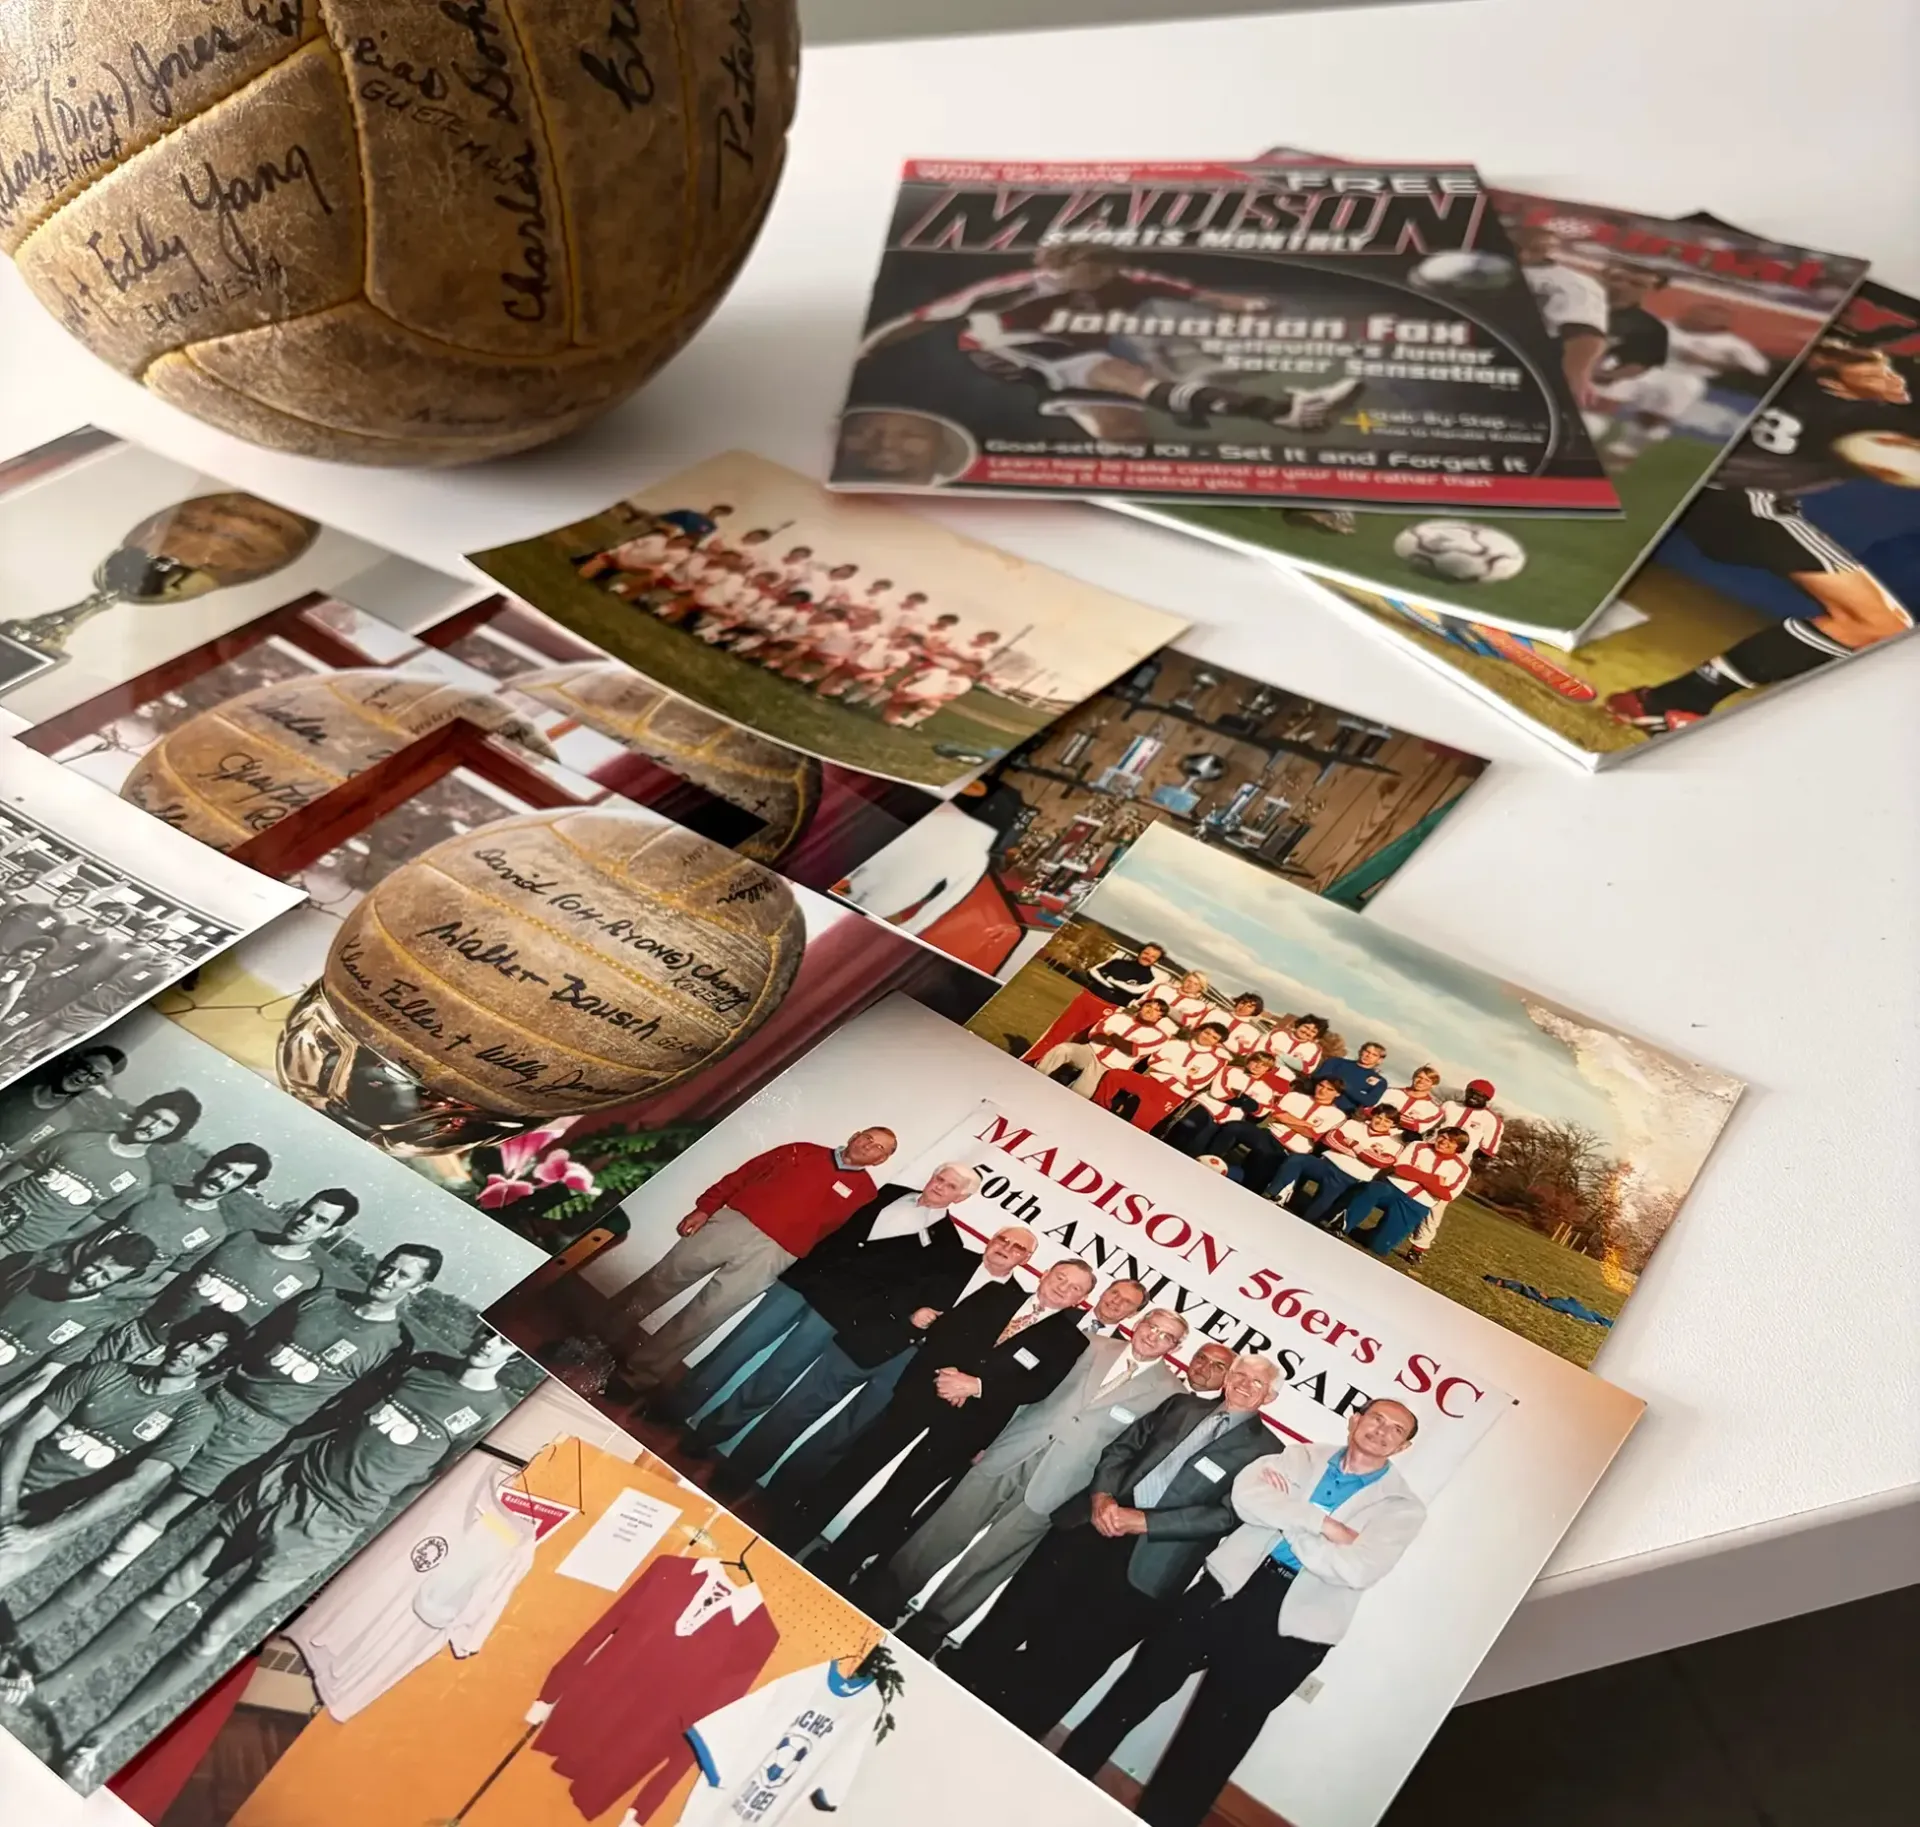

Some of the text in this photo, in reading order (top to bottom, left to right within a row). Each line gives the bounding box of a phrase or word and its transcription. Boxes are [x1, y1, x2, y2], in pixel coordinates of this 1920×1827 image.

[1287, 172, 1481, 194] FREE
[181, 144, 332, 290] Yang
[901, 185, 1488, 255] MADISON
[1037, 228, 1374, 252] SPORTS MONTHLY
[1043, 306, 1470, 345] Johnathan Fox
[1222, 354, 1523, 386] Soccer Sensation
[1218, 441, 1272, 461] Set
[1317, 448, 1377, 466] and
[1389, 450, 1494, 472] Forget
[378, 978, 447, 1041] Feller
[972, 1163, 1374, 1420] 50th ANNIVERSAR
[974, 1114, 1485, 1419] MADISON 56ers SC
